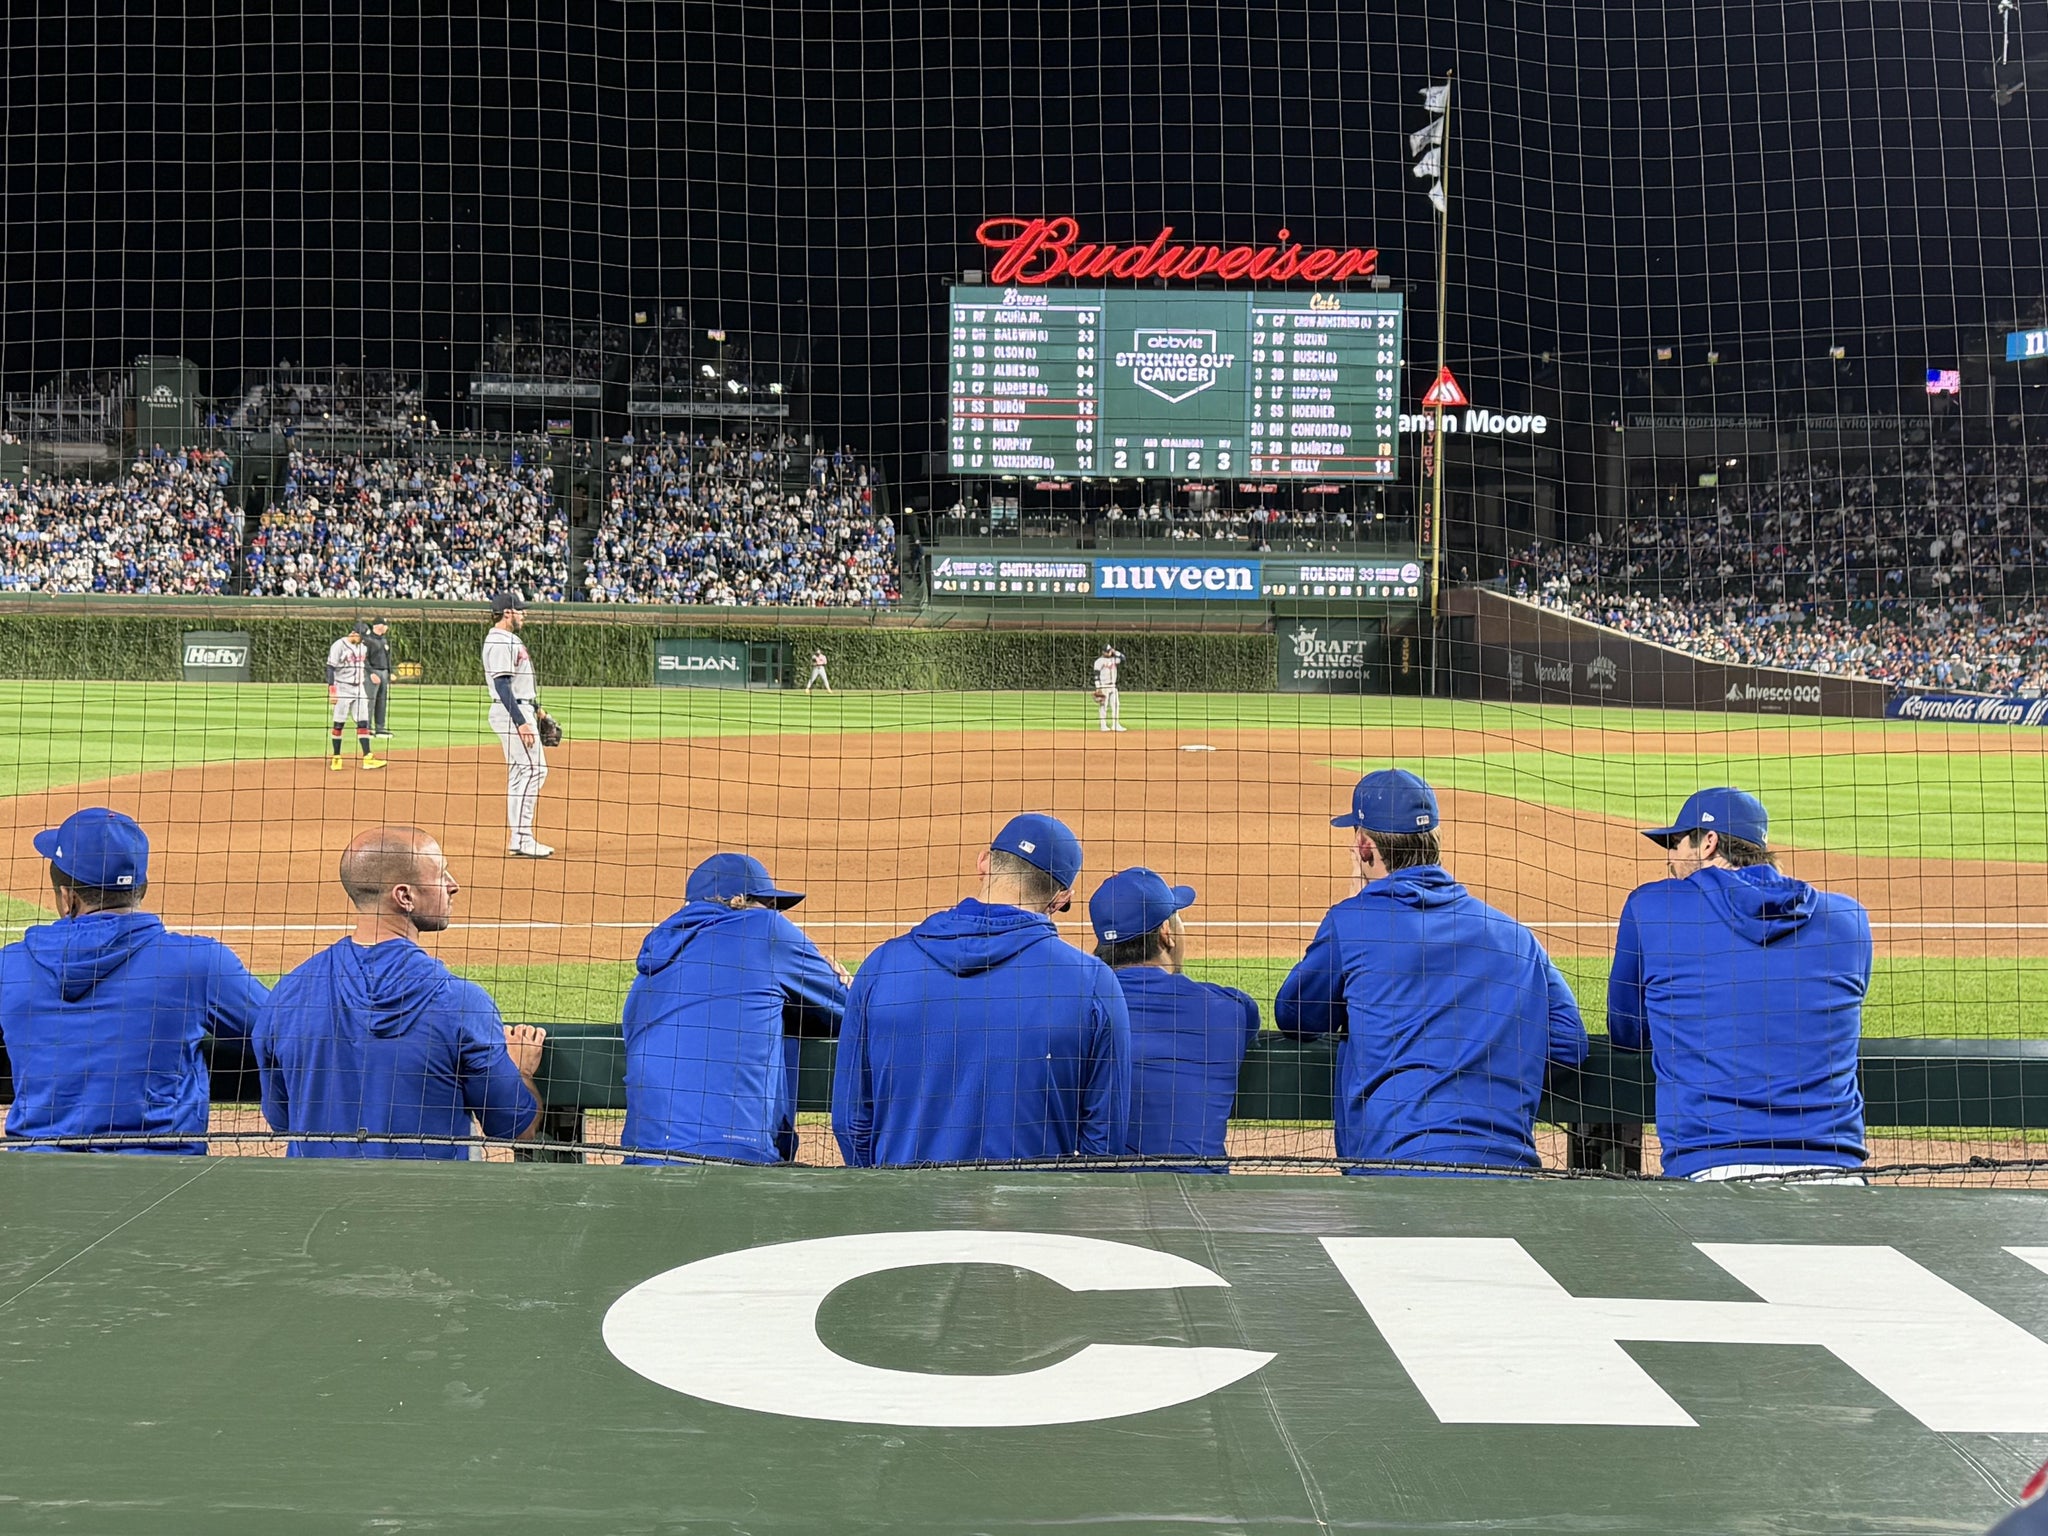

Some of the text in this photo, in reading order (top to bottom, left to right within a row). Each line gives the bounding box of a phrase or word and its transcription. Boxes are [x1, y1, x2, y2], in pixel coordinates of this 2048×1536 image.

[976, 216, 1378, 284] Budweiser
[1003, 288, 1048, 305] Braves
[1309, 292, 1340, 310] Cubs
[1256, 315, 1264, 327] 4
[1148, 335, 1203, 349] abbvie
[1293, 333, 1327, 346] SUZUKI
[994, 346, 1024, 358] OLSON
[1116, 352, 1235, 368] STRIKING OUT
[956, 364, 963, 376] 1
[1141, 367, 1209, 381] CANCER
[972, 401, 985, 413] SS
[1078, 401, 1093, 415] 1-2
[1254, 404, 1261, 417] 2
[1271, 404, 1284, 417] SS
[1375, 405, 1392, 418] 2-4
[952, 419, 965, 431] 27
[993, 419, 1020, 432] RILEY
[1465, 410, 1547, 434] Moore
[1291, 423, 1339, 437] CONFORTO
[1376, 425, 1391, 438] 1-4
[952, 437, 964, 450] 12
[974, 437, 981, 450] C
[993, 438, 1032, 451] MURPHY
[971, 454, 983, 467] LF
[1114, 451, 1230, 470] 2 1 2 3
[1272, 459, 1280, 472] C
[1291, 459, 1320, 472] KELLY
[979, 563, 994, 576] 32
[1000, 563, 1087, 578] SMITH-SHAWVER
[1101, 564, 1253, 591] nuveen
[1300, 567, 1354, 582] ROLISON
[1358, 568, 1375, 581] 33
[973, 581, 980, 591] 3
[1000, 581, 1007, 592] 2
[1027, 581, 1033, 592] 2
[1053, 582, 1060, 592] 2
[1293, 639, 1367, 656] DRAFT
[189, 648, 243, 665] Hefty
[1302, 654, 1364, 667] KINGS
[1402, 637, 1410, 675] 353
[1293, 669, 1370, 680] SPORTSBOOK
[1745, 683, 1821, 703] Invesco QQQ
[1899, 695, 2023, 726] Reynolds Wrap
[602, 1230, 2048, 1432] CH
